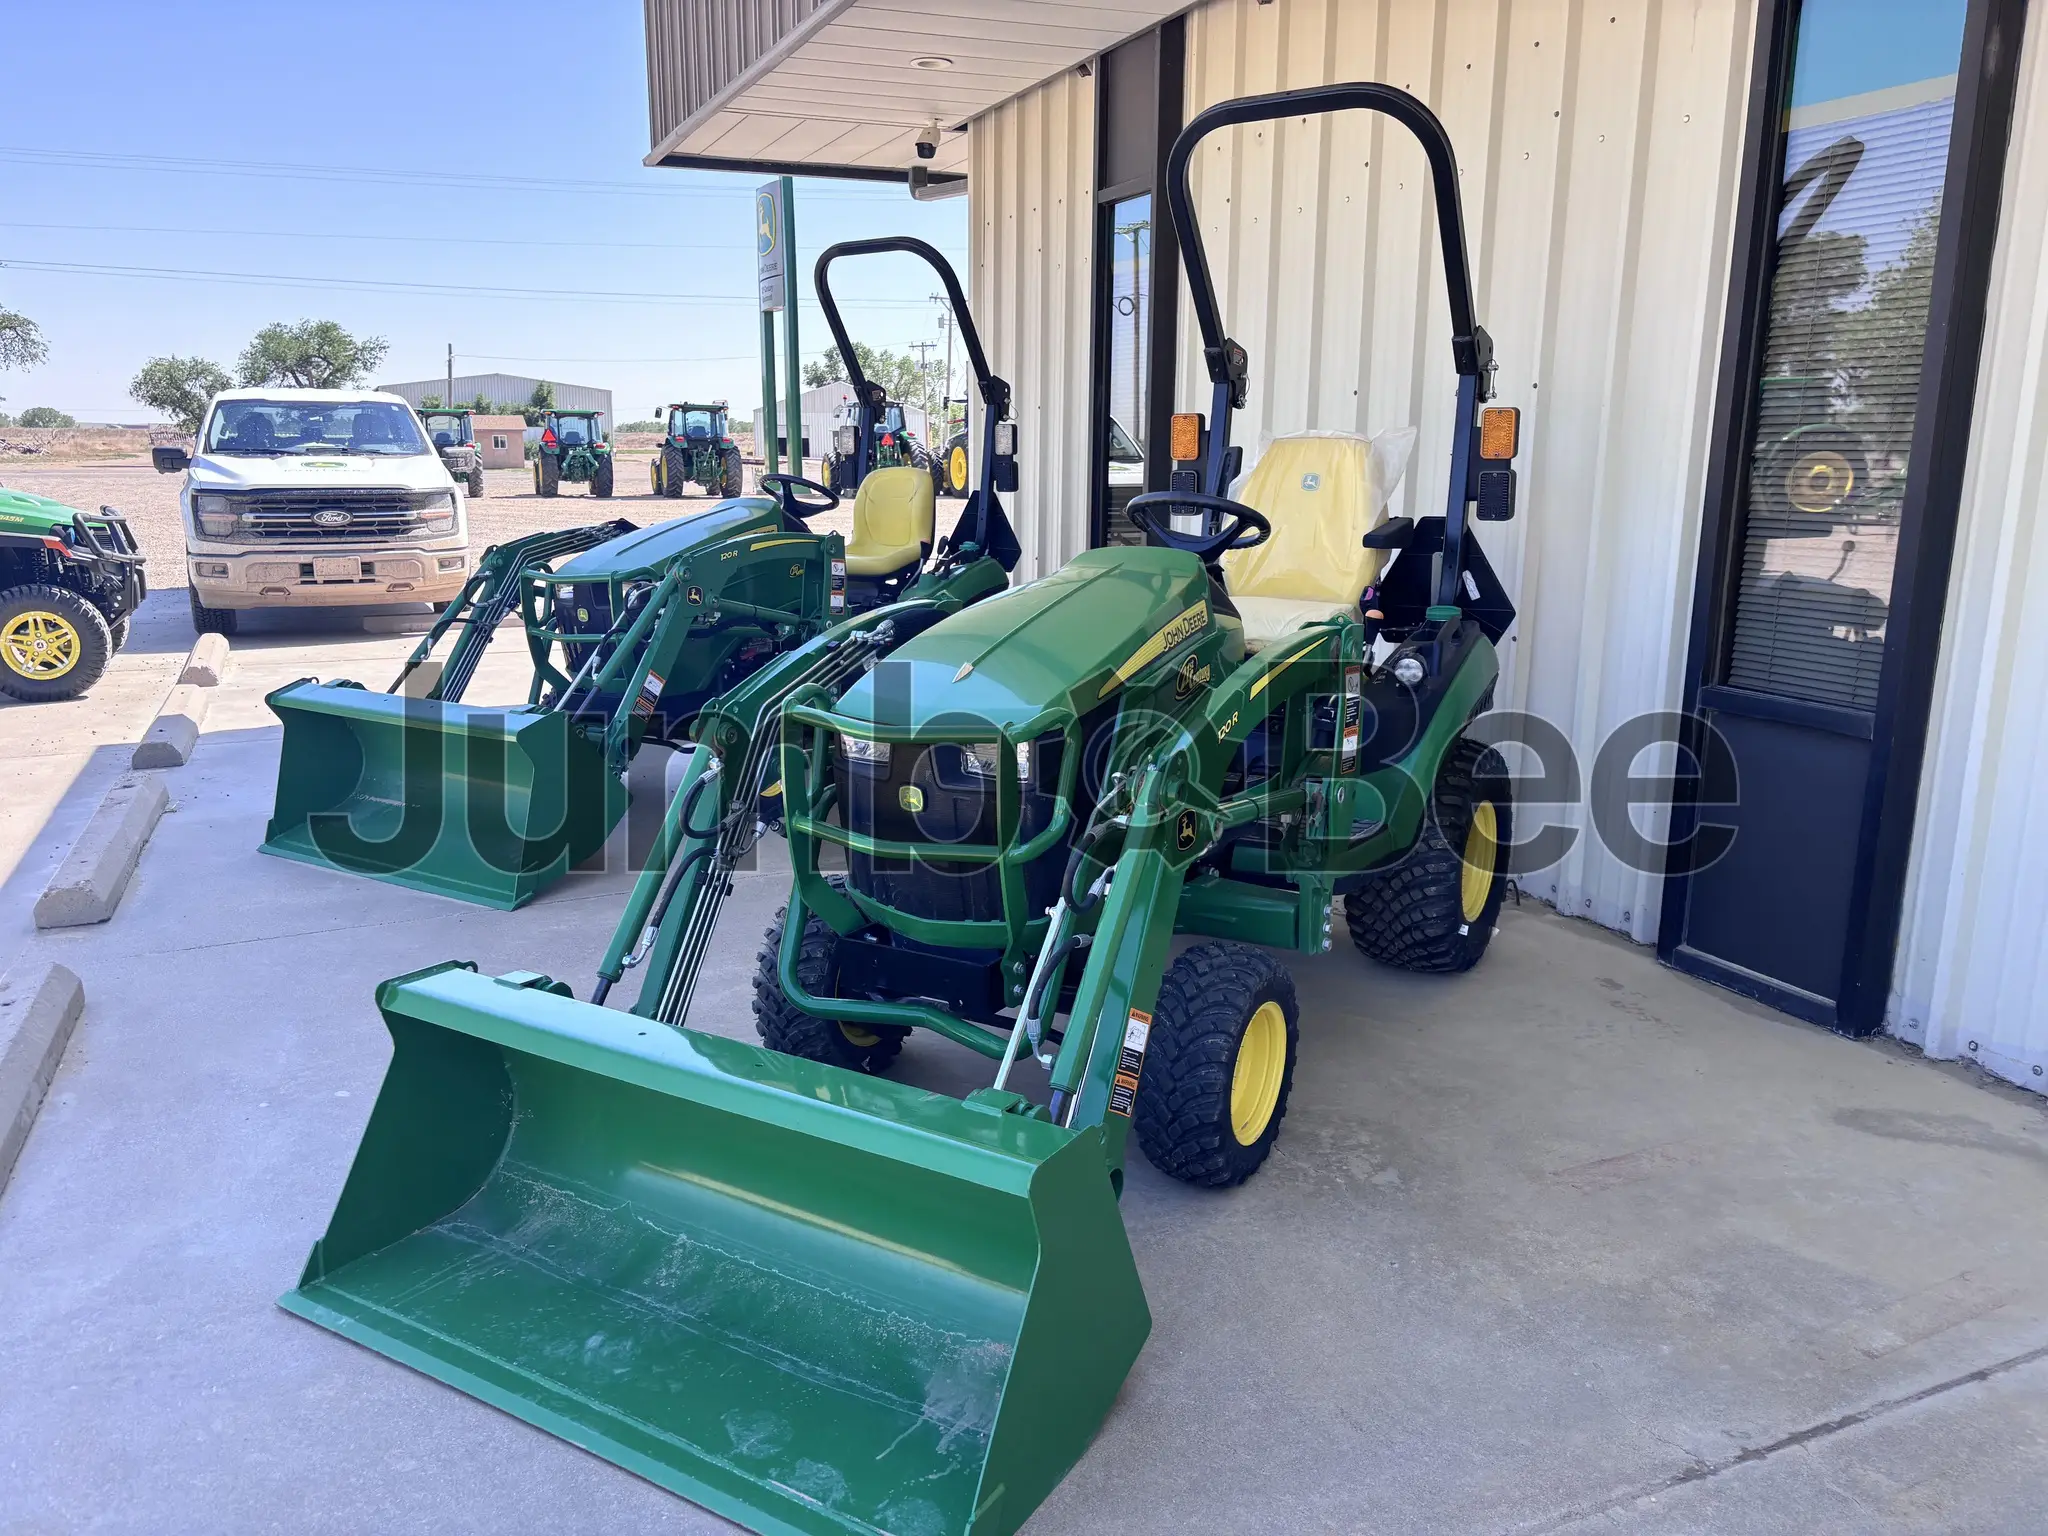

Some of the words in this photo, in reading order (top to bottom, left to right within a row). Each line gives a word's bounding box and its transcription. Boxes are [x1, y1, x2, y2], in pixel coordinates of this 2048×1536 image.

[321, 512, 344, 522] Ford
[1163, 625, 1184, 651] JOHN
[1183, 610, 1207, 636] DEERE
